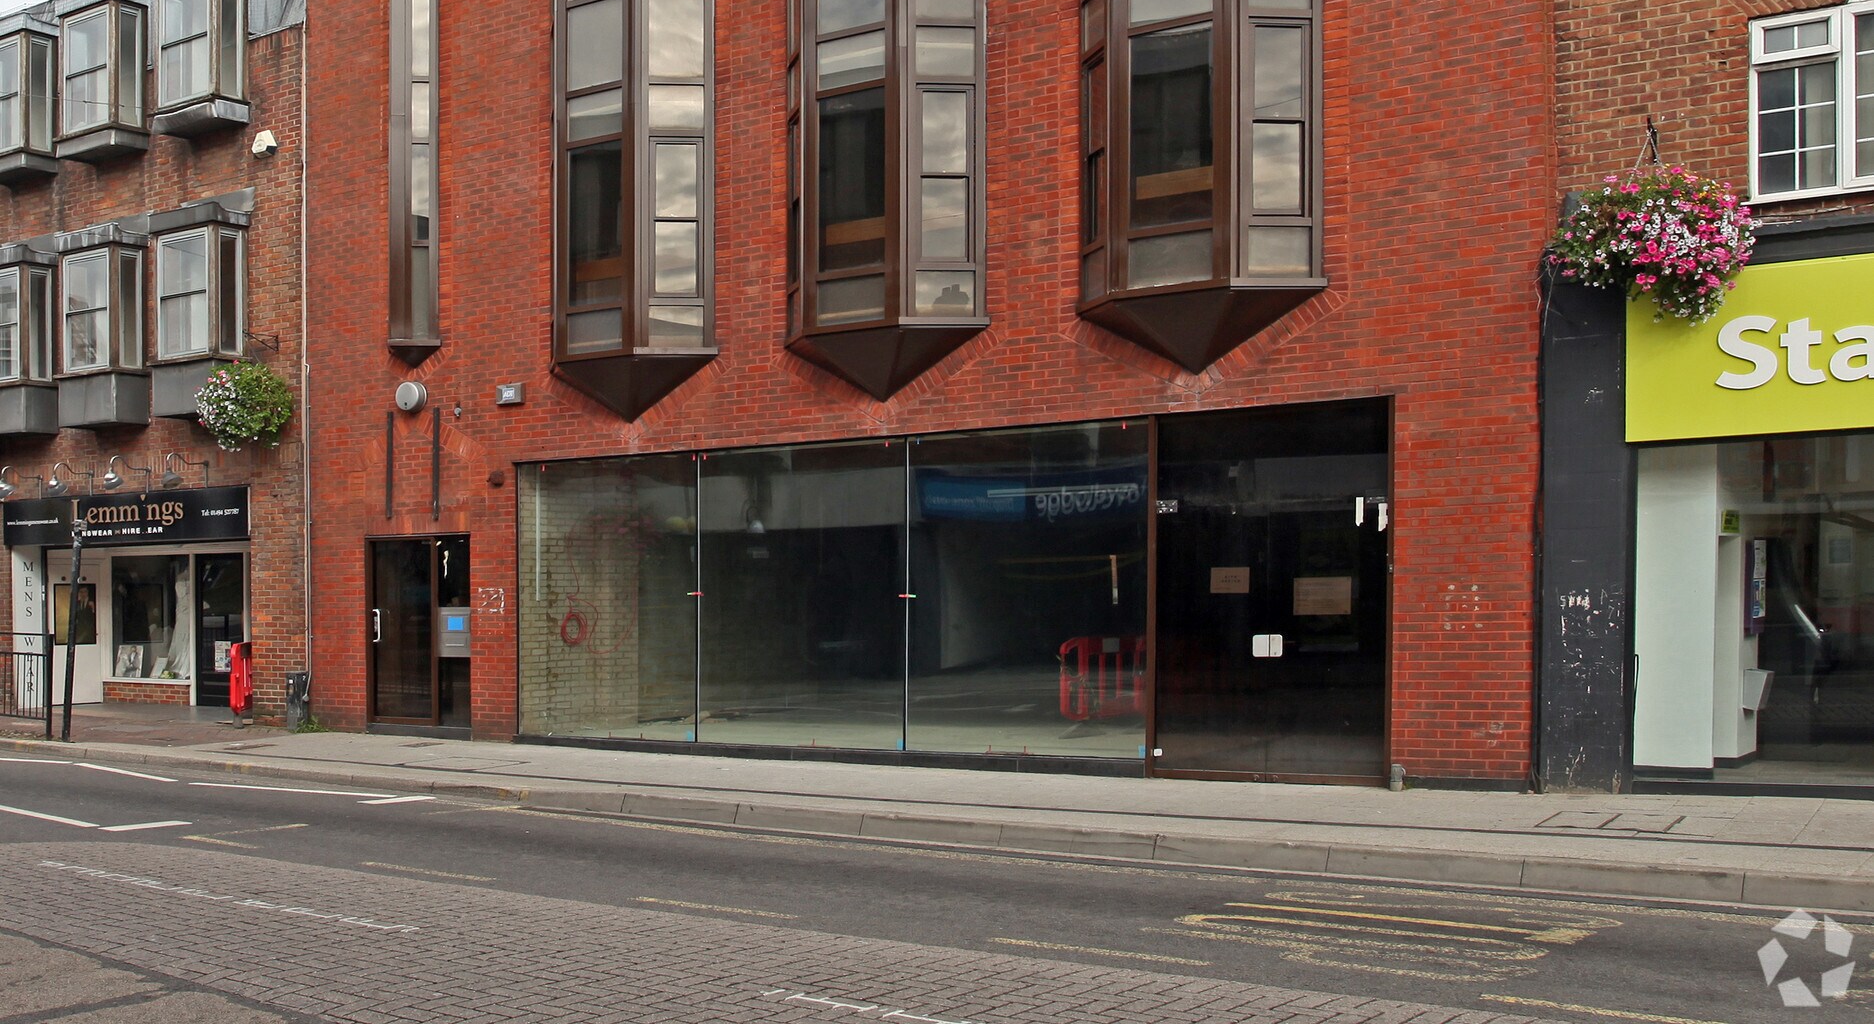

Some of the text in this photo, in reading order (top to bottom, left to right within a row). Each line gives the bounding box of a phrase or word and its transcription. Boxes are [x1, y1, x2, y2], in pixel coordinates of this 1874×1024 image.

[1715, 315, 1874, 390] Sta
[71, 494, 184, 525] Lemmngs
[121, 527, 141, 535] HIRE
[142, 526, 163, 534] EAR
[23, 561, 34, 617] MENS
